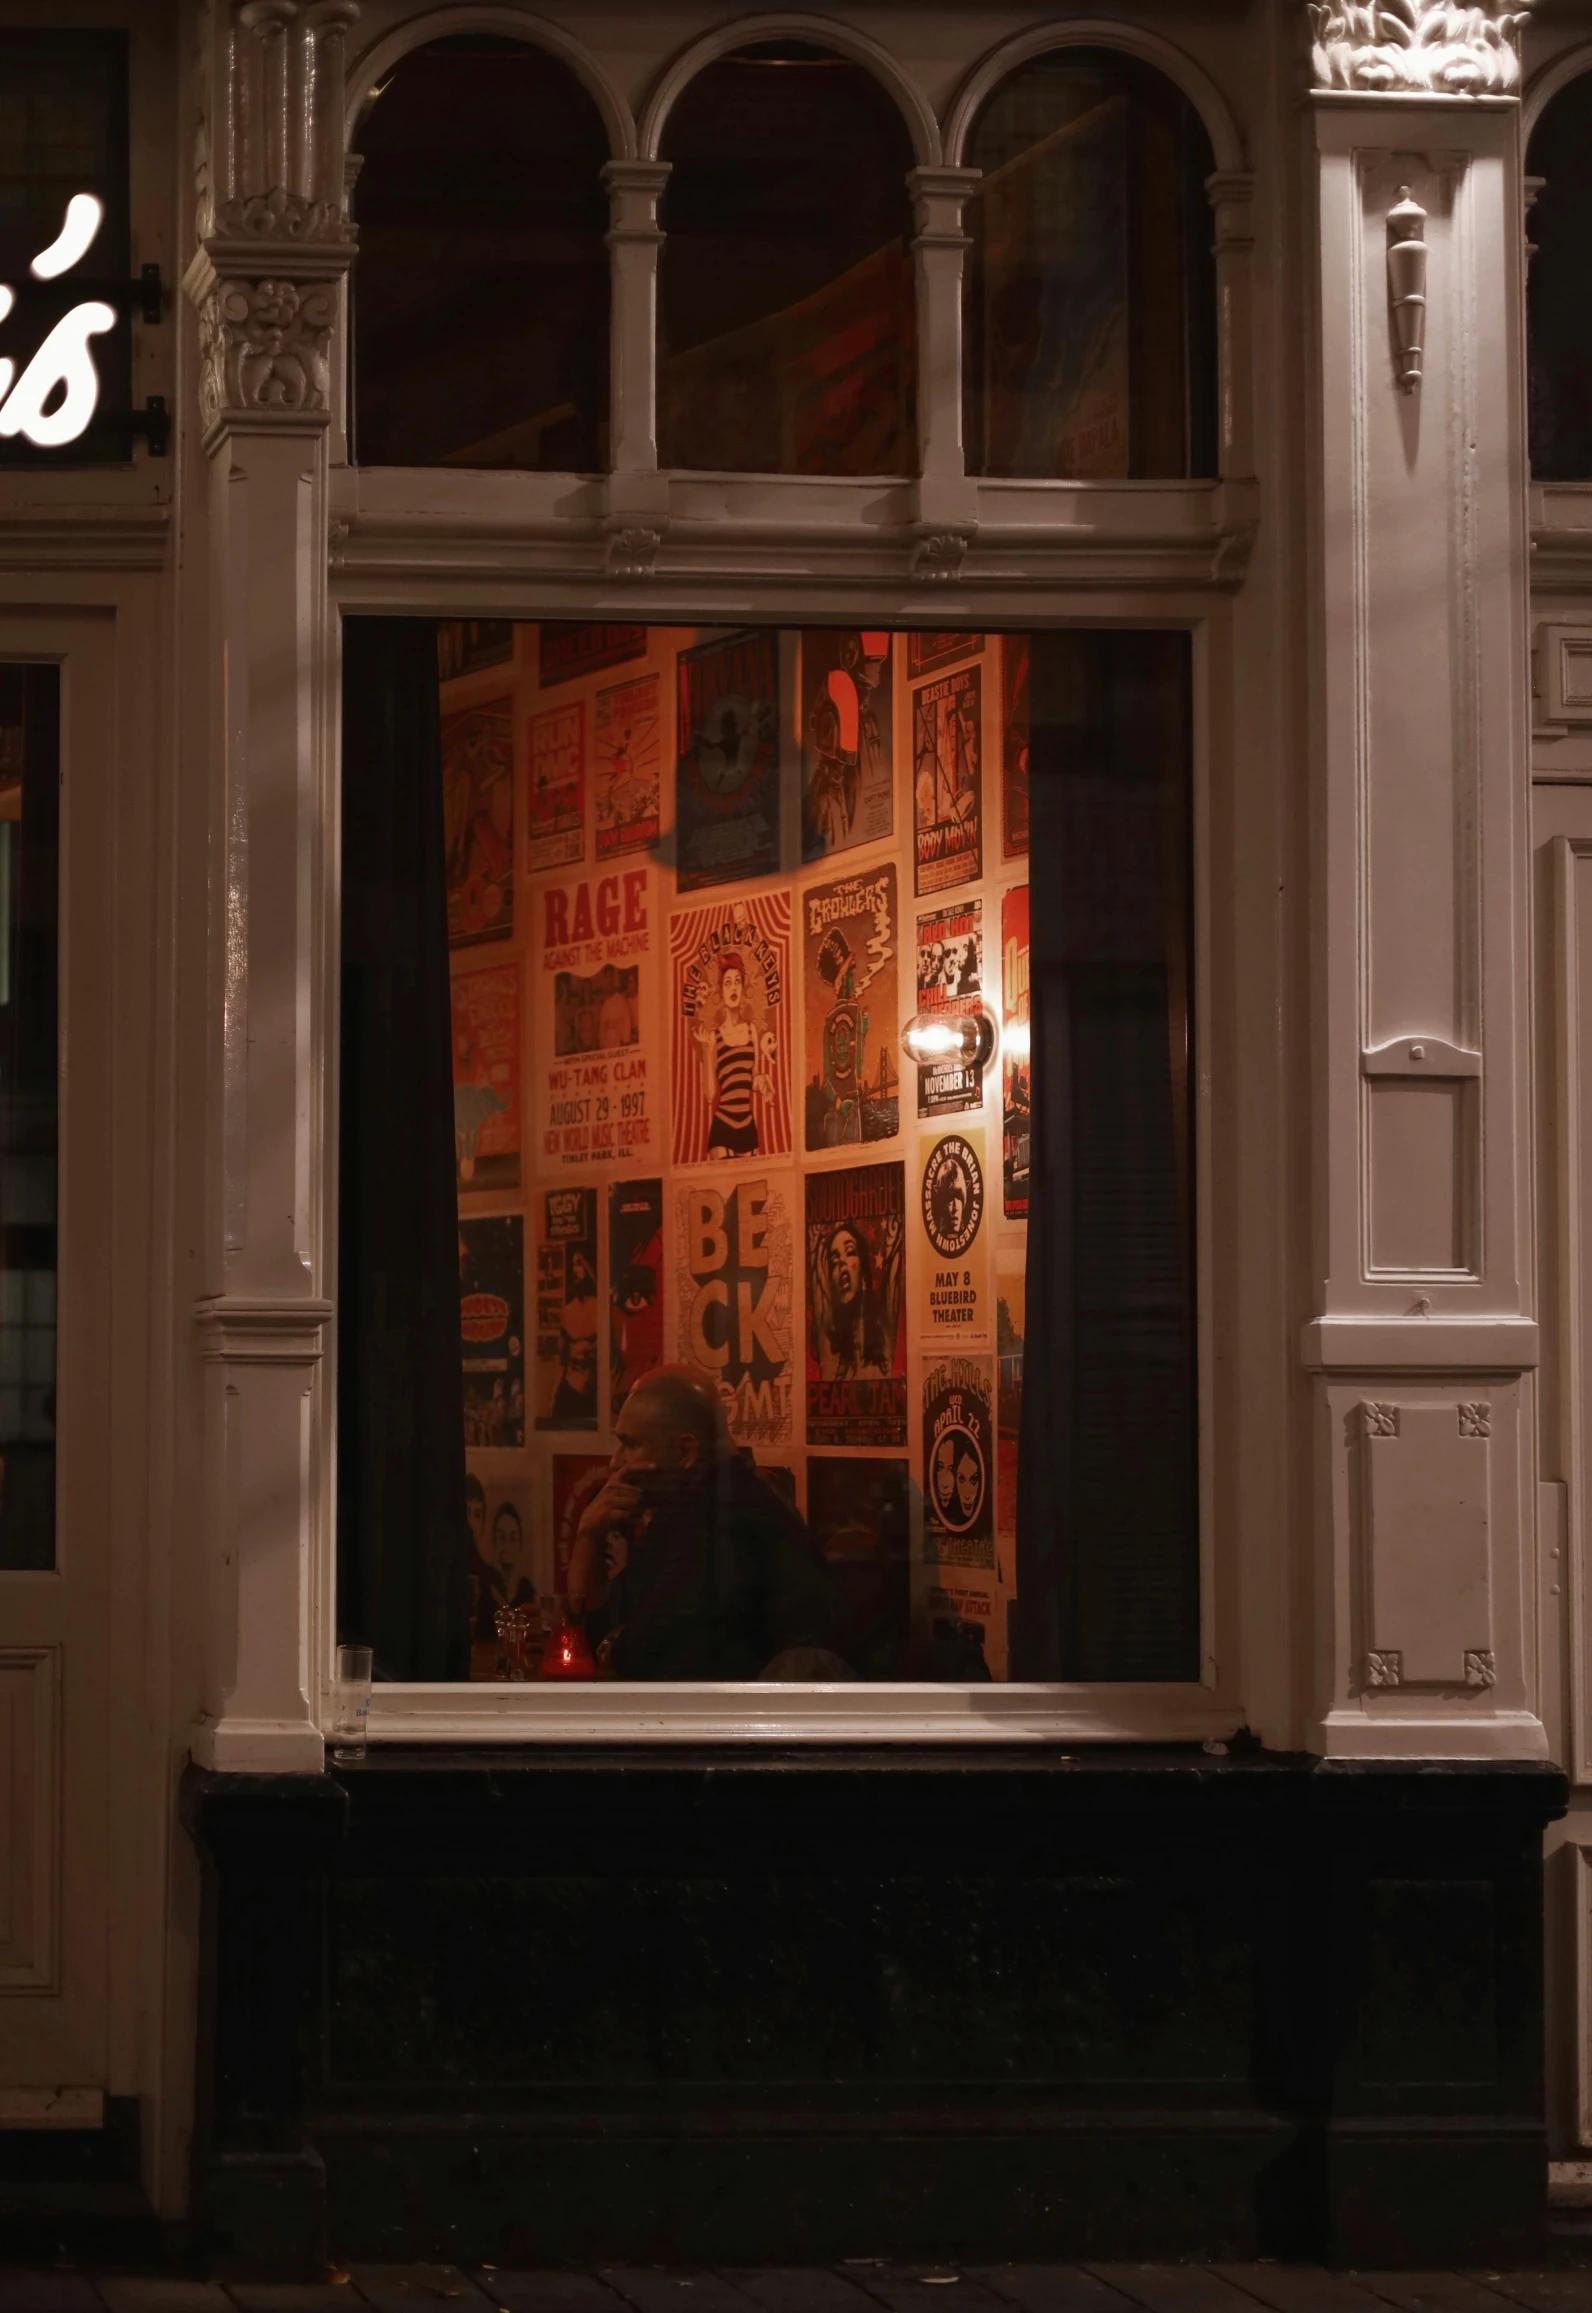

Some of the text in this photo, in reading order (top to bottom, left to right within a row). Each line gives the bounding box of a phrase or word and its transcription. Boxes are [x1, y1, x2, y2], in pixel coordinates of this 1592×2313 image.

[921, 680, 950, 705] BEASTIE
[951, 673, 970, 694] BOYS
[533, 716, 580, 757] RUN
[533, 746, 581, 791] DMC
[917, 829, 943, 861] BODY
[832, 879, 864, 895] THE
[544, 869, 647, 949] RAGE
[808, 877, 890, 936] GROWLERS
[949, 912, 975, 937] HOT
[543, 932, 650, 972] AGAINST THE MACHINE
[682, 964, 703, 1017] THE
[699, 922, 757, 967] BLACK
[754, 939, 781, 1007] KEYS
[581, 1053, 606, 1062] SPECIAL
[607, 1048, 629, 1059] GUEST
[548, 1059, 647, 1091] WU-TANG CLAN
[924, 1069, 976, 1096] NOVEMBER 13
[549, 1090, 646, 1127] AUGUST 29 1997
[563, 1125, 589, 1153] WORLD
[591, 1122, 616, 1150] MUSIC
[617, 1117, 651, 1147] THEATRE
[562, 1152, 589, 1164] TINLEY
[591, 1149, 616, 1161] PARK,
[547, 1193, 582, 1216] IGGY
[924, 1141, 981, 1252] THE BRIAN JONESTOWN MASSACRE
[935, 1270, 971, 1288] MAY 8
[930, 1289, 977, 1306] BLUEBIRD
[933, 1308, 974, 1323] THEATER
[807, 1379, 907, 1416] PEARL JAM
[923, 1364, 947, 1409] THE
[934, 1405, 964, 1439] APRIL
[967, 1412, 980, 1440] 22
[964, 1600, 991, 1617] ATTACK
